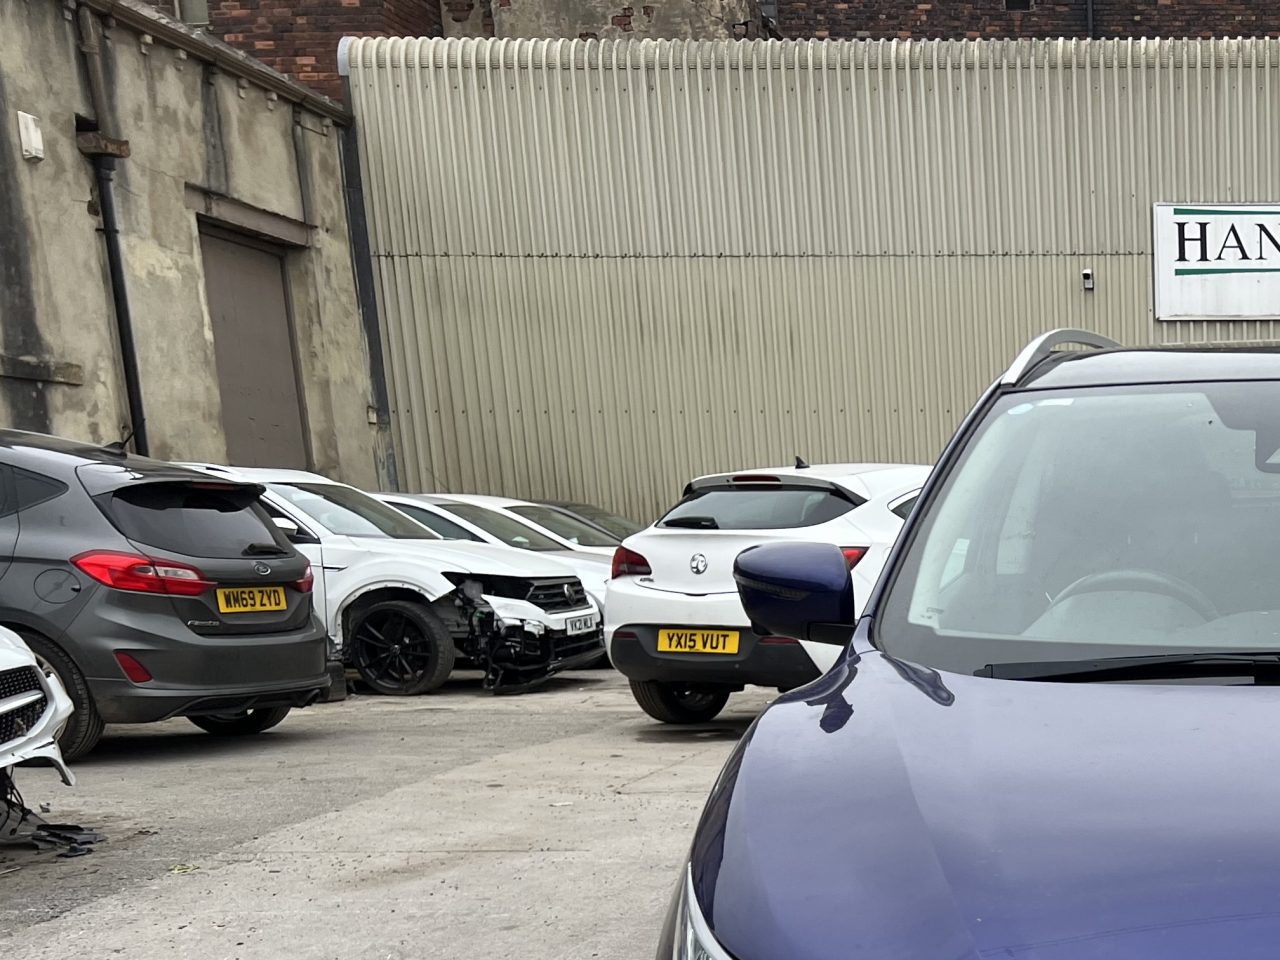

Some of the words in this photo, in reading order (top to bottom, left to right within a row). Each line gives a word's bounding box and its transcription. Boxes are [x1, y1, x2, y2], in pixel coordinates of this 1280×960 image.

[223, 590, 256, 609] WM69
[258, 589, 281, 607] ZYD
[667, 632, 697, 649] YX15
[701, 633, 730, 650] VUT
